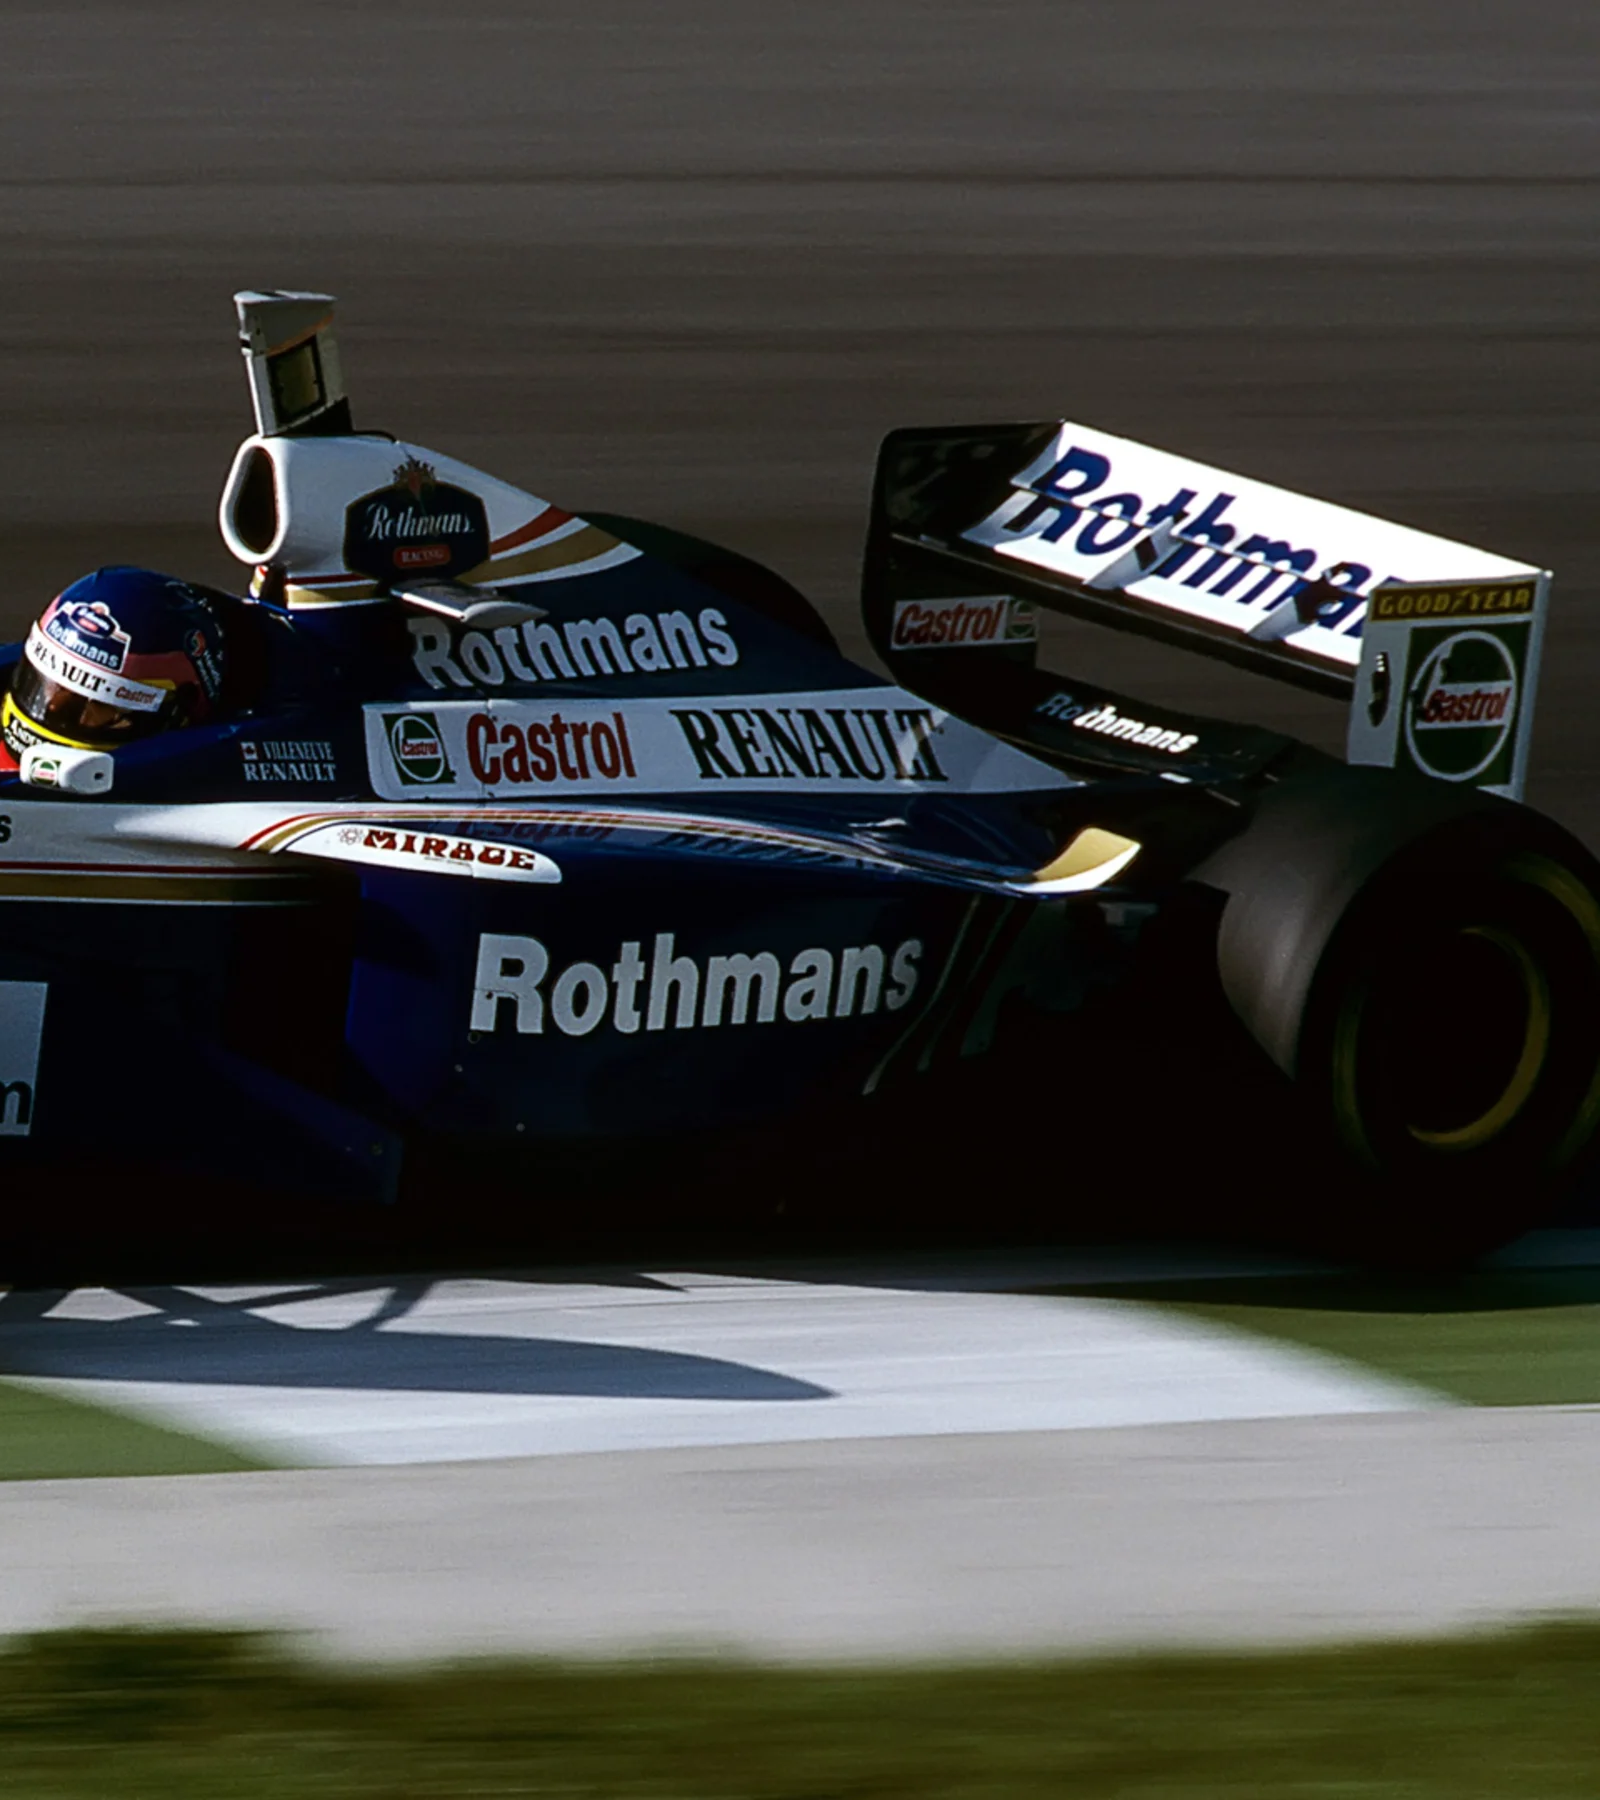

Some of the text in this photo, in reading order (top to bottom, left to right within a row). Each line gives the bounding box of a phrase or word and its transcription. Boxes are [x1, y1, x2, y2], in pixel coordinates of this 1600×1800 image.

[367, 502, 476, 540] Rothmans
[894, 601, 1004, 644] Castrol
[1378, 588, 1531, 616] GOODYEAR
[407, 608, 740, 690] Rothmans
[1035, 693, 1199, 755] Rothmans
[1422, 688, 1508, 723] Castrol
[262, 741, 335, 761] VILLENEUVE
[466, 706, 949, 784] Castrol RENAULT
[242, 762, 337, 783] RENAULT
[363, 829, 535, 871] MIRAGE
[469, 932, 923, 1036] Rothmans
